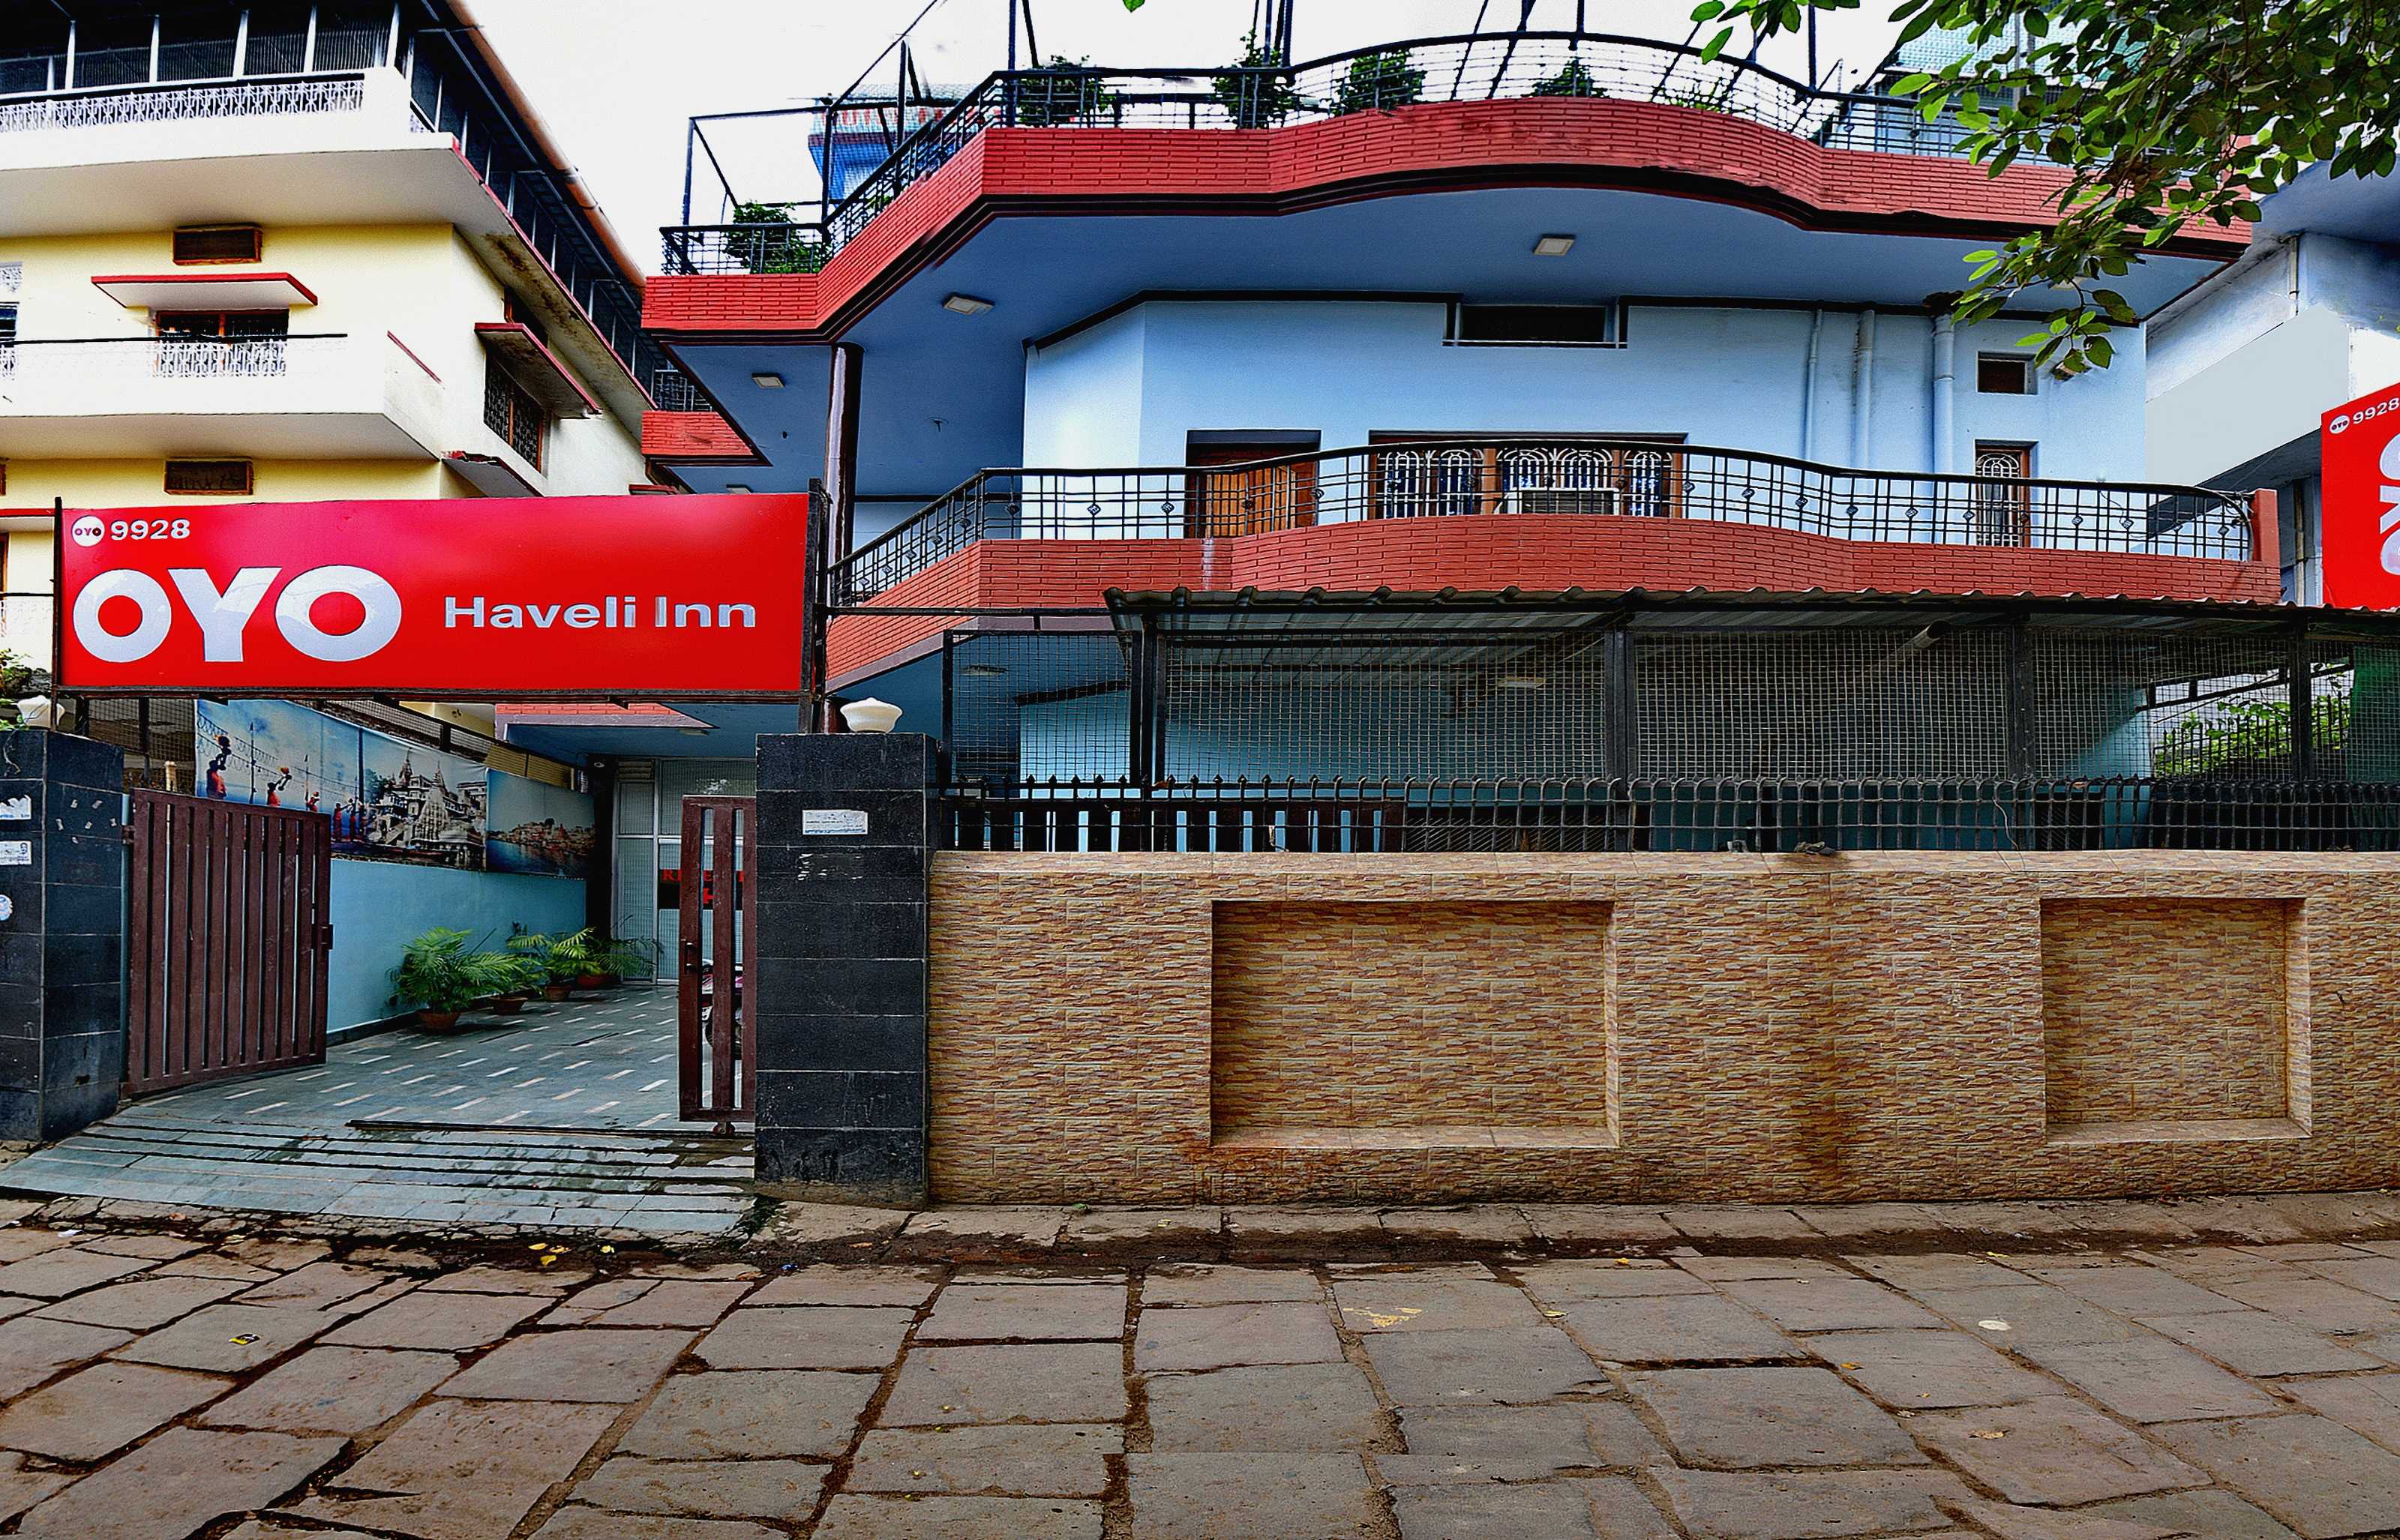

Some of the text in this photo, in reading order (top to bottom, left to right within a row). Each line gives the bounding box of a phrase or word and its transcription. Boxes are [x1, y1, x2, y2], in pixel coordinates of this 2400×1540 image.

[2331, 397, 2400, 430] OYO 9928
[75, 518, 190, 541] OYO 9928
[73, 565, 402, 662] OYO
[444, 596, 757, 628] Haveli Inn
